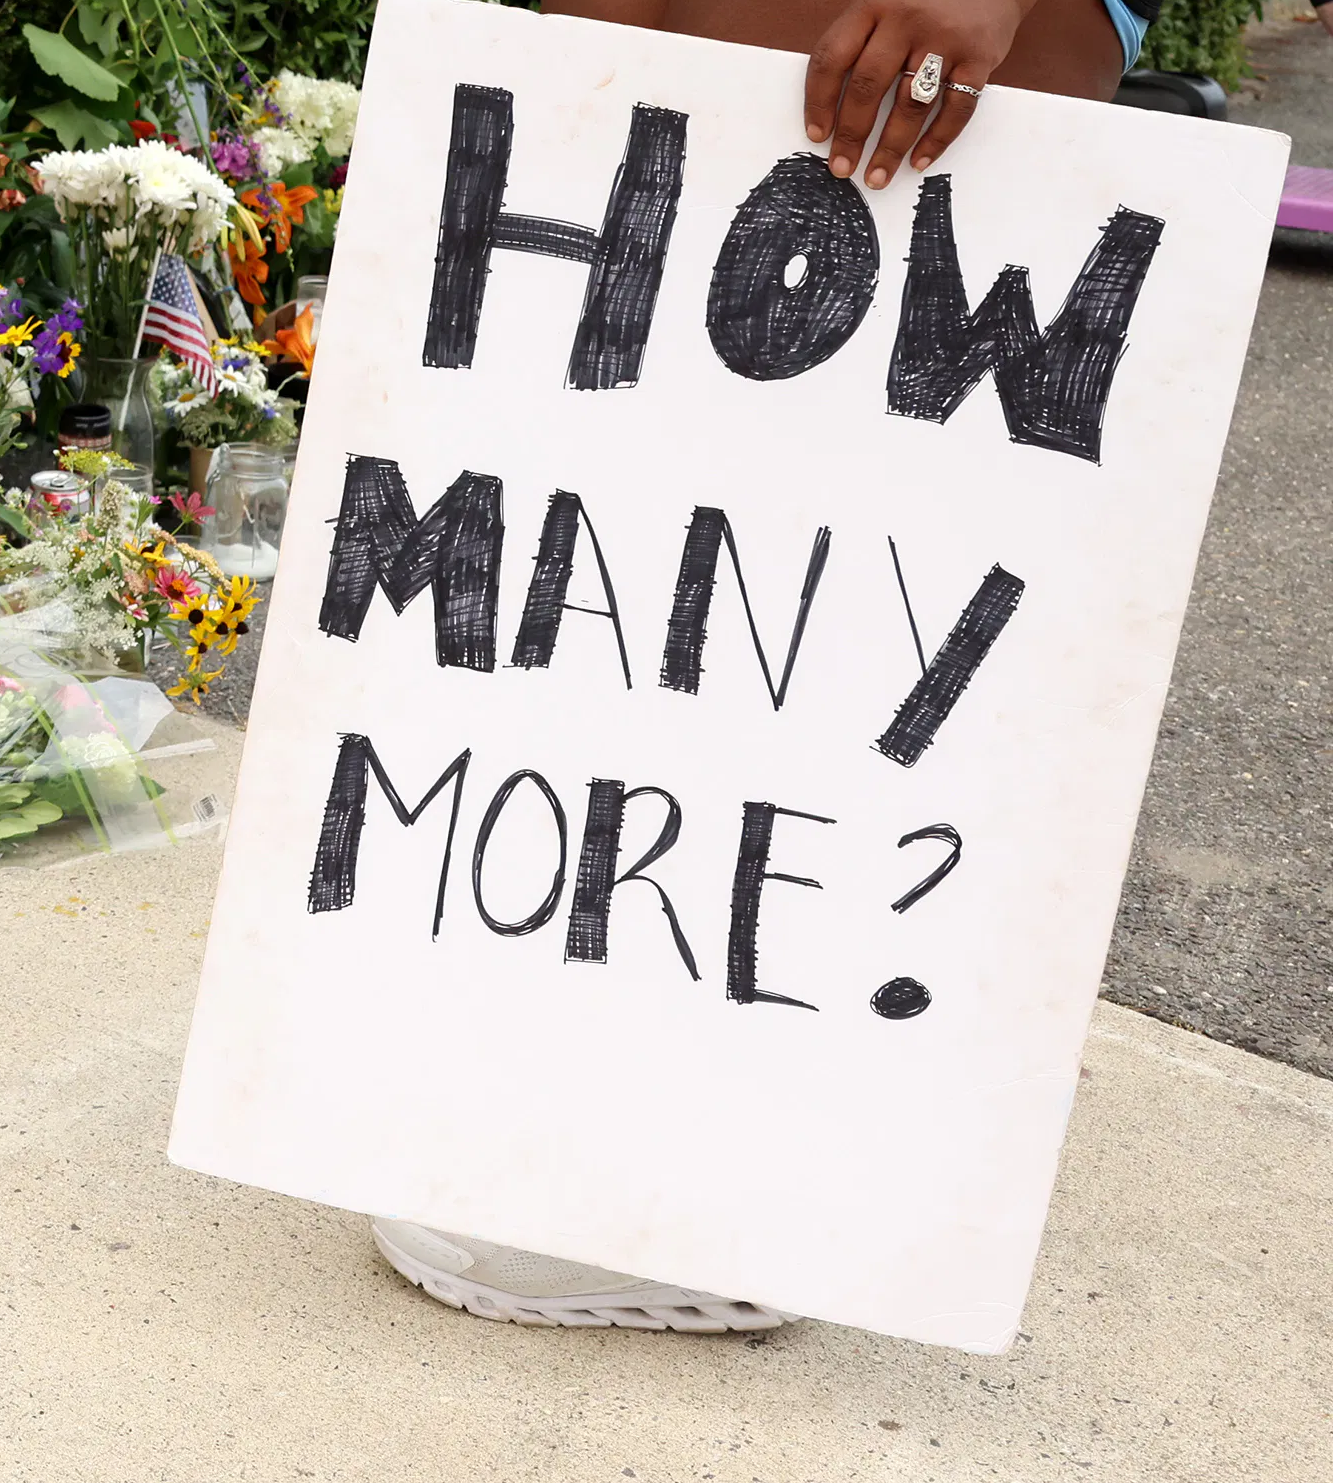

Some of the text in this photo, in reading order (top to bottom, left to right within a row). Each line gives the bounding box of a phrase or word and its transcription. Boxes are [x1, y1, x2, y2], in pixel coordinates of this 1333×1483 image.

[421, 82, 1166, 468] HOW
[318, 450, 1027, 769] MANY
[307, 731, 965, 1021] MORE?
